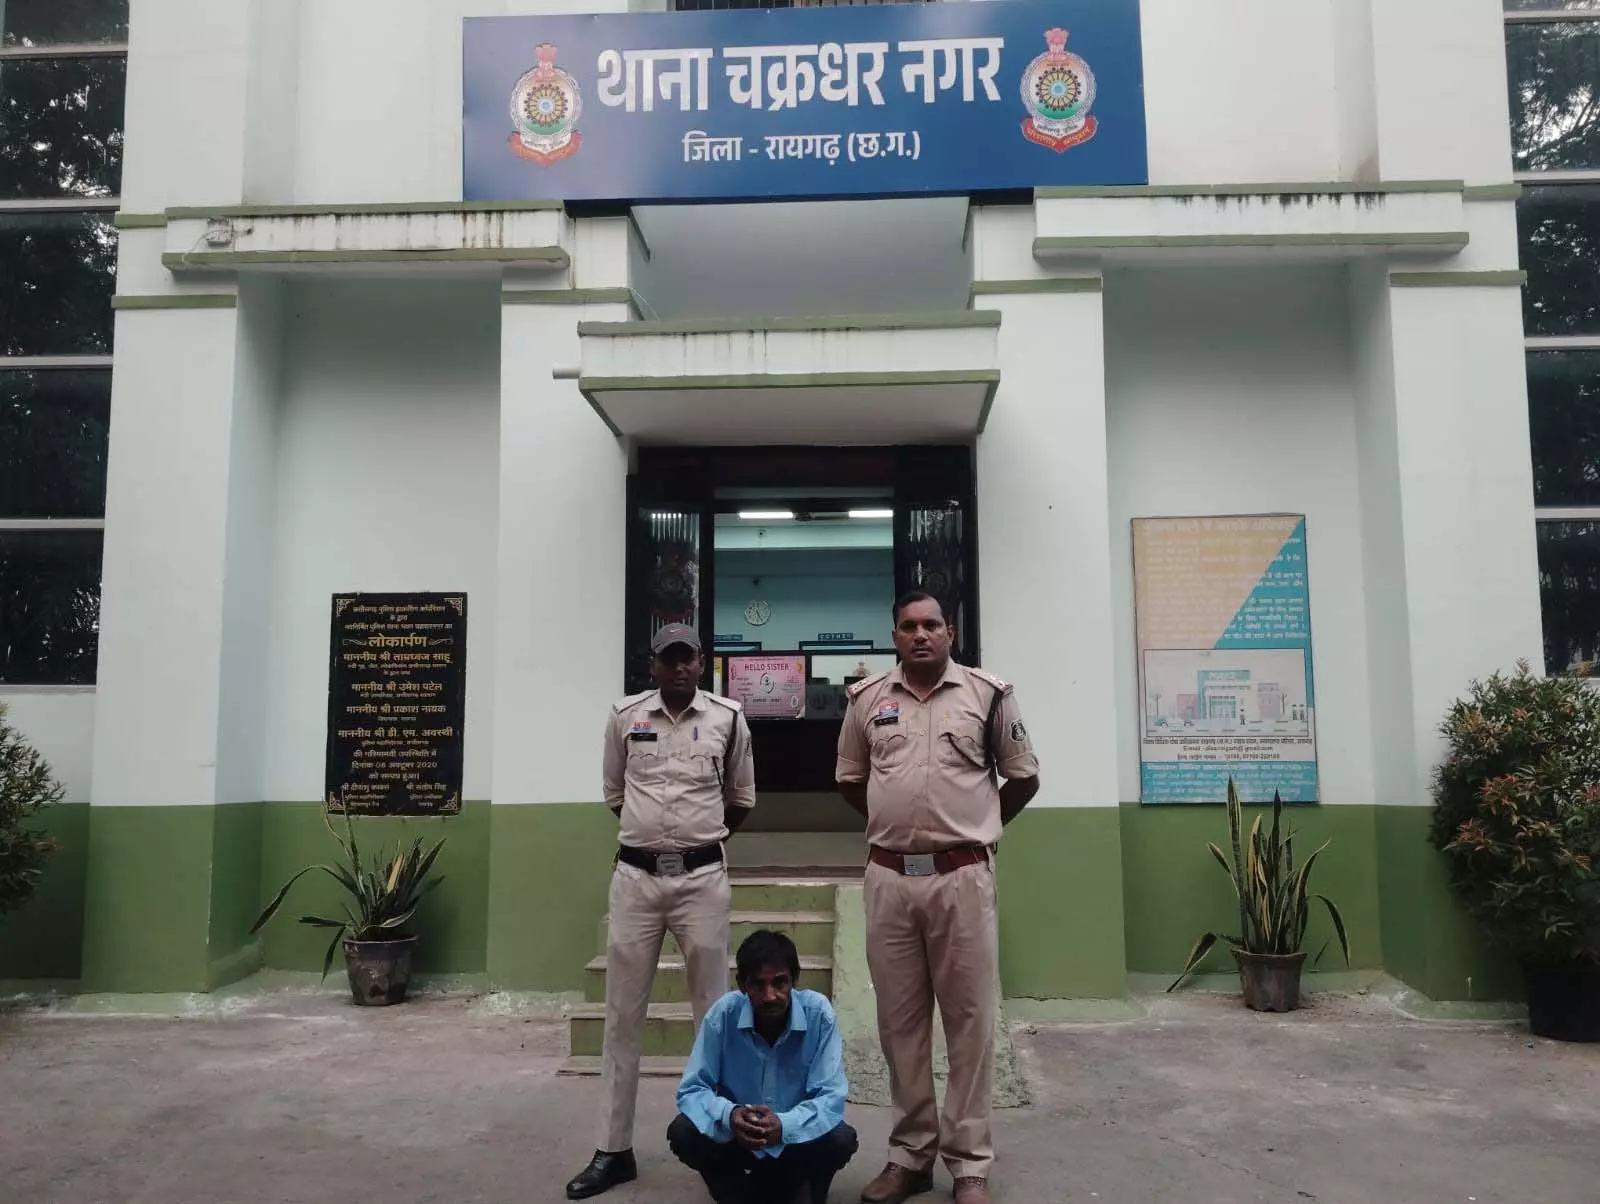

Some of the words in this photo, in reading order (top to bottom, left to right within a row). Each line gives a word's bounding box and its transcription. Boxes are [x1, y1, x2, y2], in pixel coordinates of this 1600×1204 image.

[597, 48, 713, 113] थाना
[723, 41, 886, 110] चक्रधर
[898, 37, 1005, 104] नगर
[681, 131, 744, 163] जिला
[764, 132, 842, 167] रायगढ़
[847, 131, 922, 163] (छ.ग.)
[367, 633, 428, 648] लोकार्पण
[343, 651, 377, 661] माननीय
[379, 650, 391, 661] श्री
[744, 663, 766, 672] HELLO
[767, 663, 789, 671] SISTER
[351, 681, 383, 691] माननीय
[386, 680, 397, 691] श्री
[422, 681, 442, 691] पटेल
[346, 703, 378, 714] माननीय
[381, 703, 391, 713] श्री
[338, 727, 371, 738] माननीय
[374, 727, 384, 737] श्री
[417, 761, 438, 769] 2020
